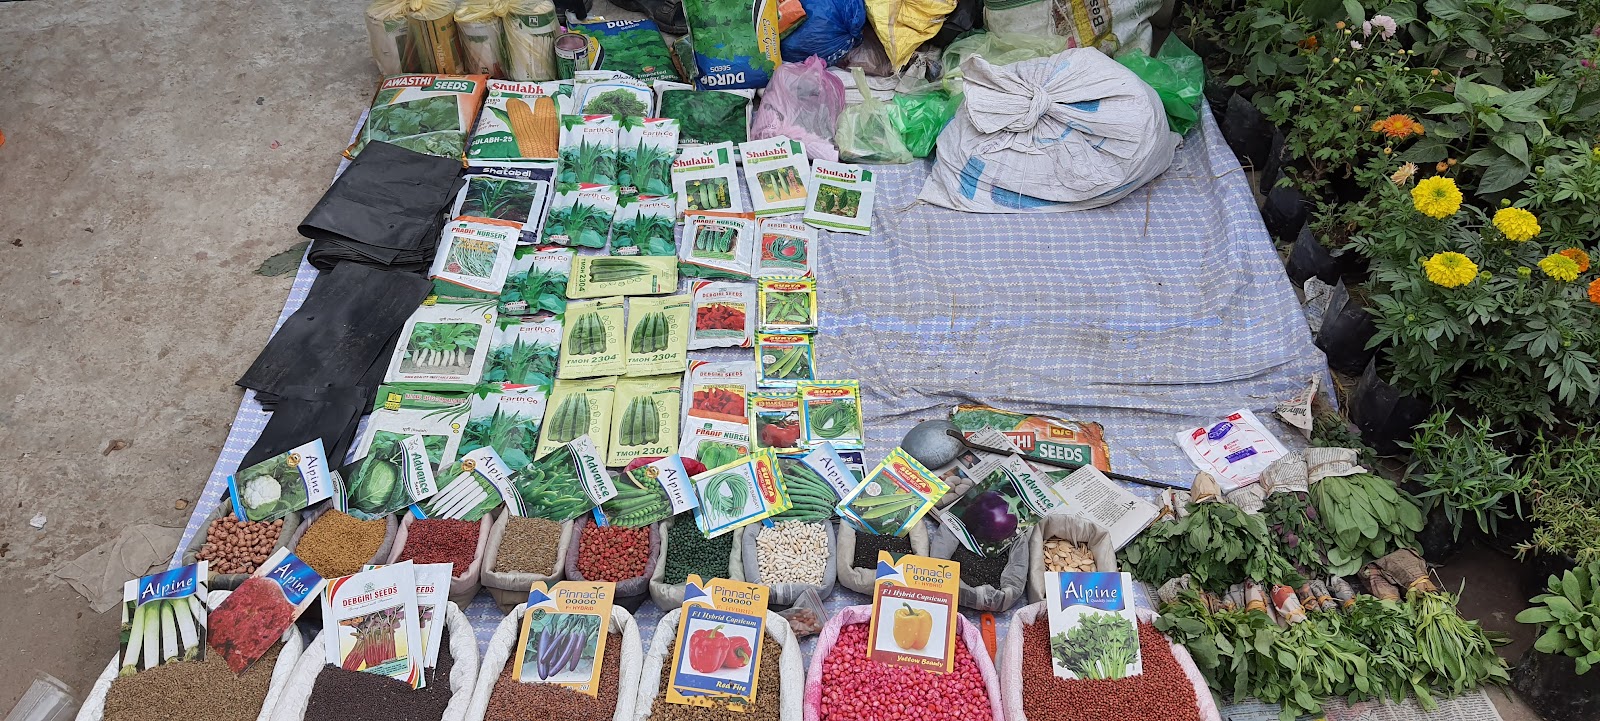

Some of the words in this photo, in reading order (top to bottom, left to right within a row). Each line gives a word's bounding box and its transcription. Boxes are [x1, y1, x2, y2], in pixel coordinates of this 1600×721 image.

[384, 76, 432, 87] AWASTHI
[434, 81, 468, 90] SEEDS
[700, 72, 745, 86] DURGA
[746, 148, 788, 158] Shulabh
[673, 156, 714, 168] Shulabh
[482, 167, 532, 178] Shatabdi
[816, 166, 856, 179] Shulabh
[476, 230, 507, 240] NURSERY
[578, 274, 586, 292] 2304
[520, 326, 542, 334] Earth
[544, 326, 556, 334] Co
[592, 354, 617, 363] 2304
[652, 353, 677, 362] 2304
[500, 395, 524, 403] Earth
[526, 396, 538, 405] Co
[724, 432, 750, 441] NURSE
[642, 446, 670, 455] 2304
[1039, 444, 1083, 463] SEEDS
[306, 455, 320, 494] Alpine
[414, 452, 430, 494] Advance
[480, 454, 503, 481] Alpi
[583, 454, 610, 497] Advance
[760, 466, 774, 497] SURYA
[819, 457, 850, 495] Alpine
[899, 466, 927, 489] SURYA
[592, 484, 602, 500] Seeds
[664, 468, 684, 506] Alpine
[1019, 472, 1054, 509] Advance
[1034, 500, 1048, 512] Seeds
[906, 564, 952, 579] Pinnacle
[274, 563, 310, 596] Alpine
[142, 576, 193, 598] Alpine
[559, 586, 606, 600] Pinnacle
[714, 586, 760, 600] Pinnacle
[1065, 581, 1118, 603] Alpine
[342, 592, 372, 607] DEBGIRI
[374, 586, 398, 598] SEEDS
[893, 590, 916, 599] Hybrid
[916, 594, 948, 604] Capsicum
[702, 612, 724, 621] Hybrid
[726, 615, 756, 626] Capsicum
